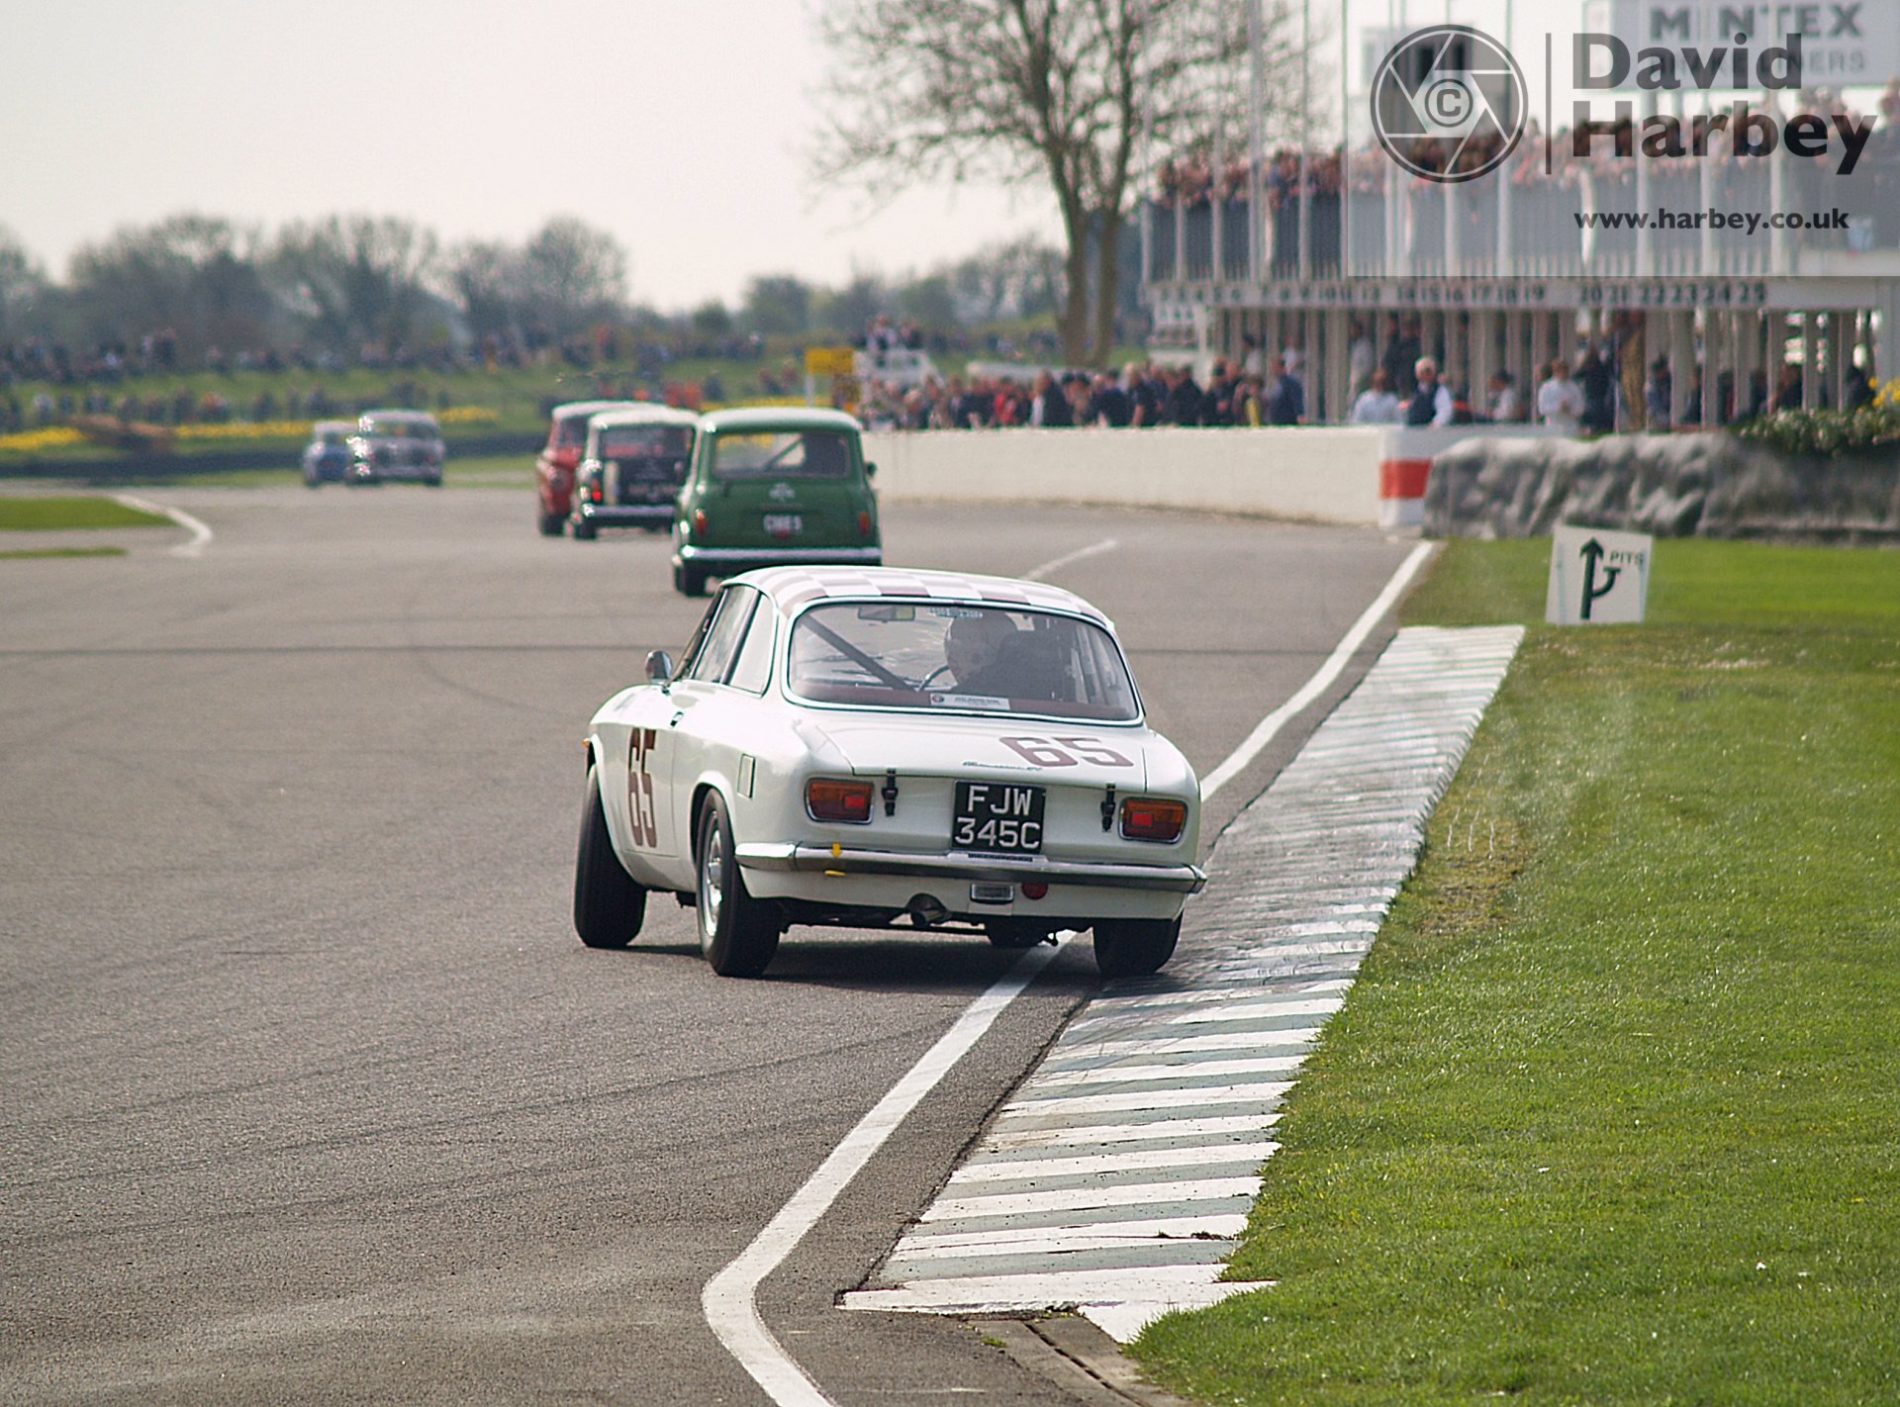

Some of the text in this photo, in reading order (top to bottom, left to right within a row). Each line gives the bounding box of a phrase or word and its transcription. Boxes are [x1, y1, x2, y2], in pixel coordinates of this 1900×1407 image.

[1650, 3, 1862, 40] MNTEX
[1609, 550, 1645, 565] PITS
[999, 737, 1134, 767] 65
[628, 727, 657, 848] 65
[967, 785, 1033, 817] FJW
[954, 817, 1041, 849] 345C
